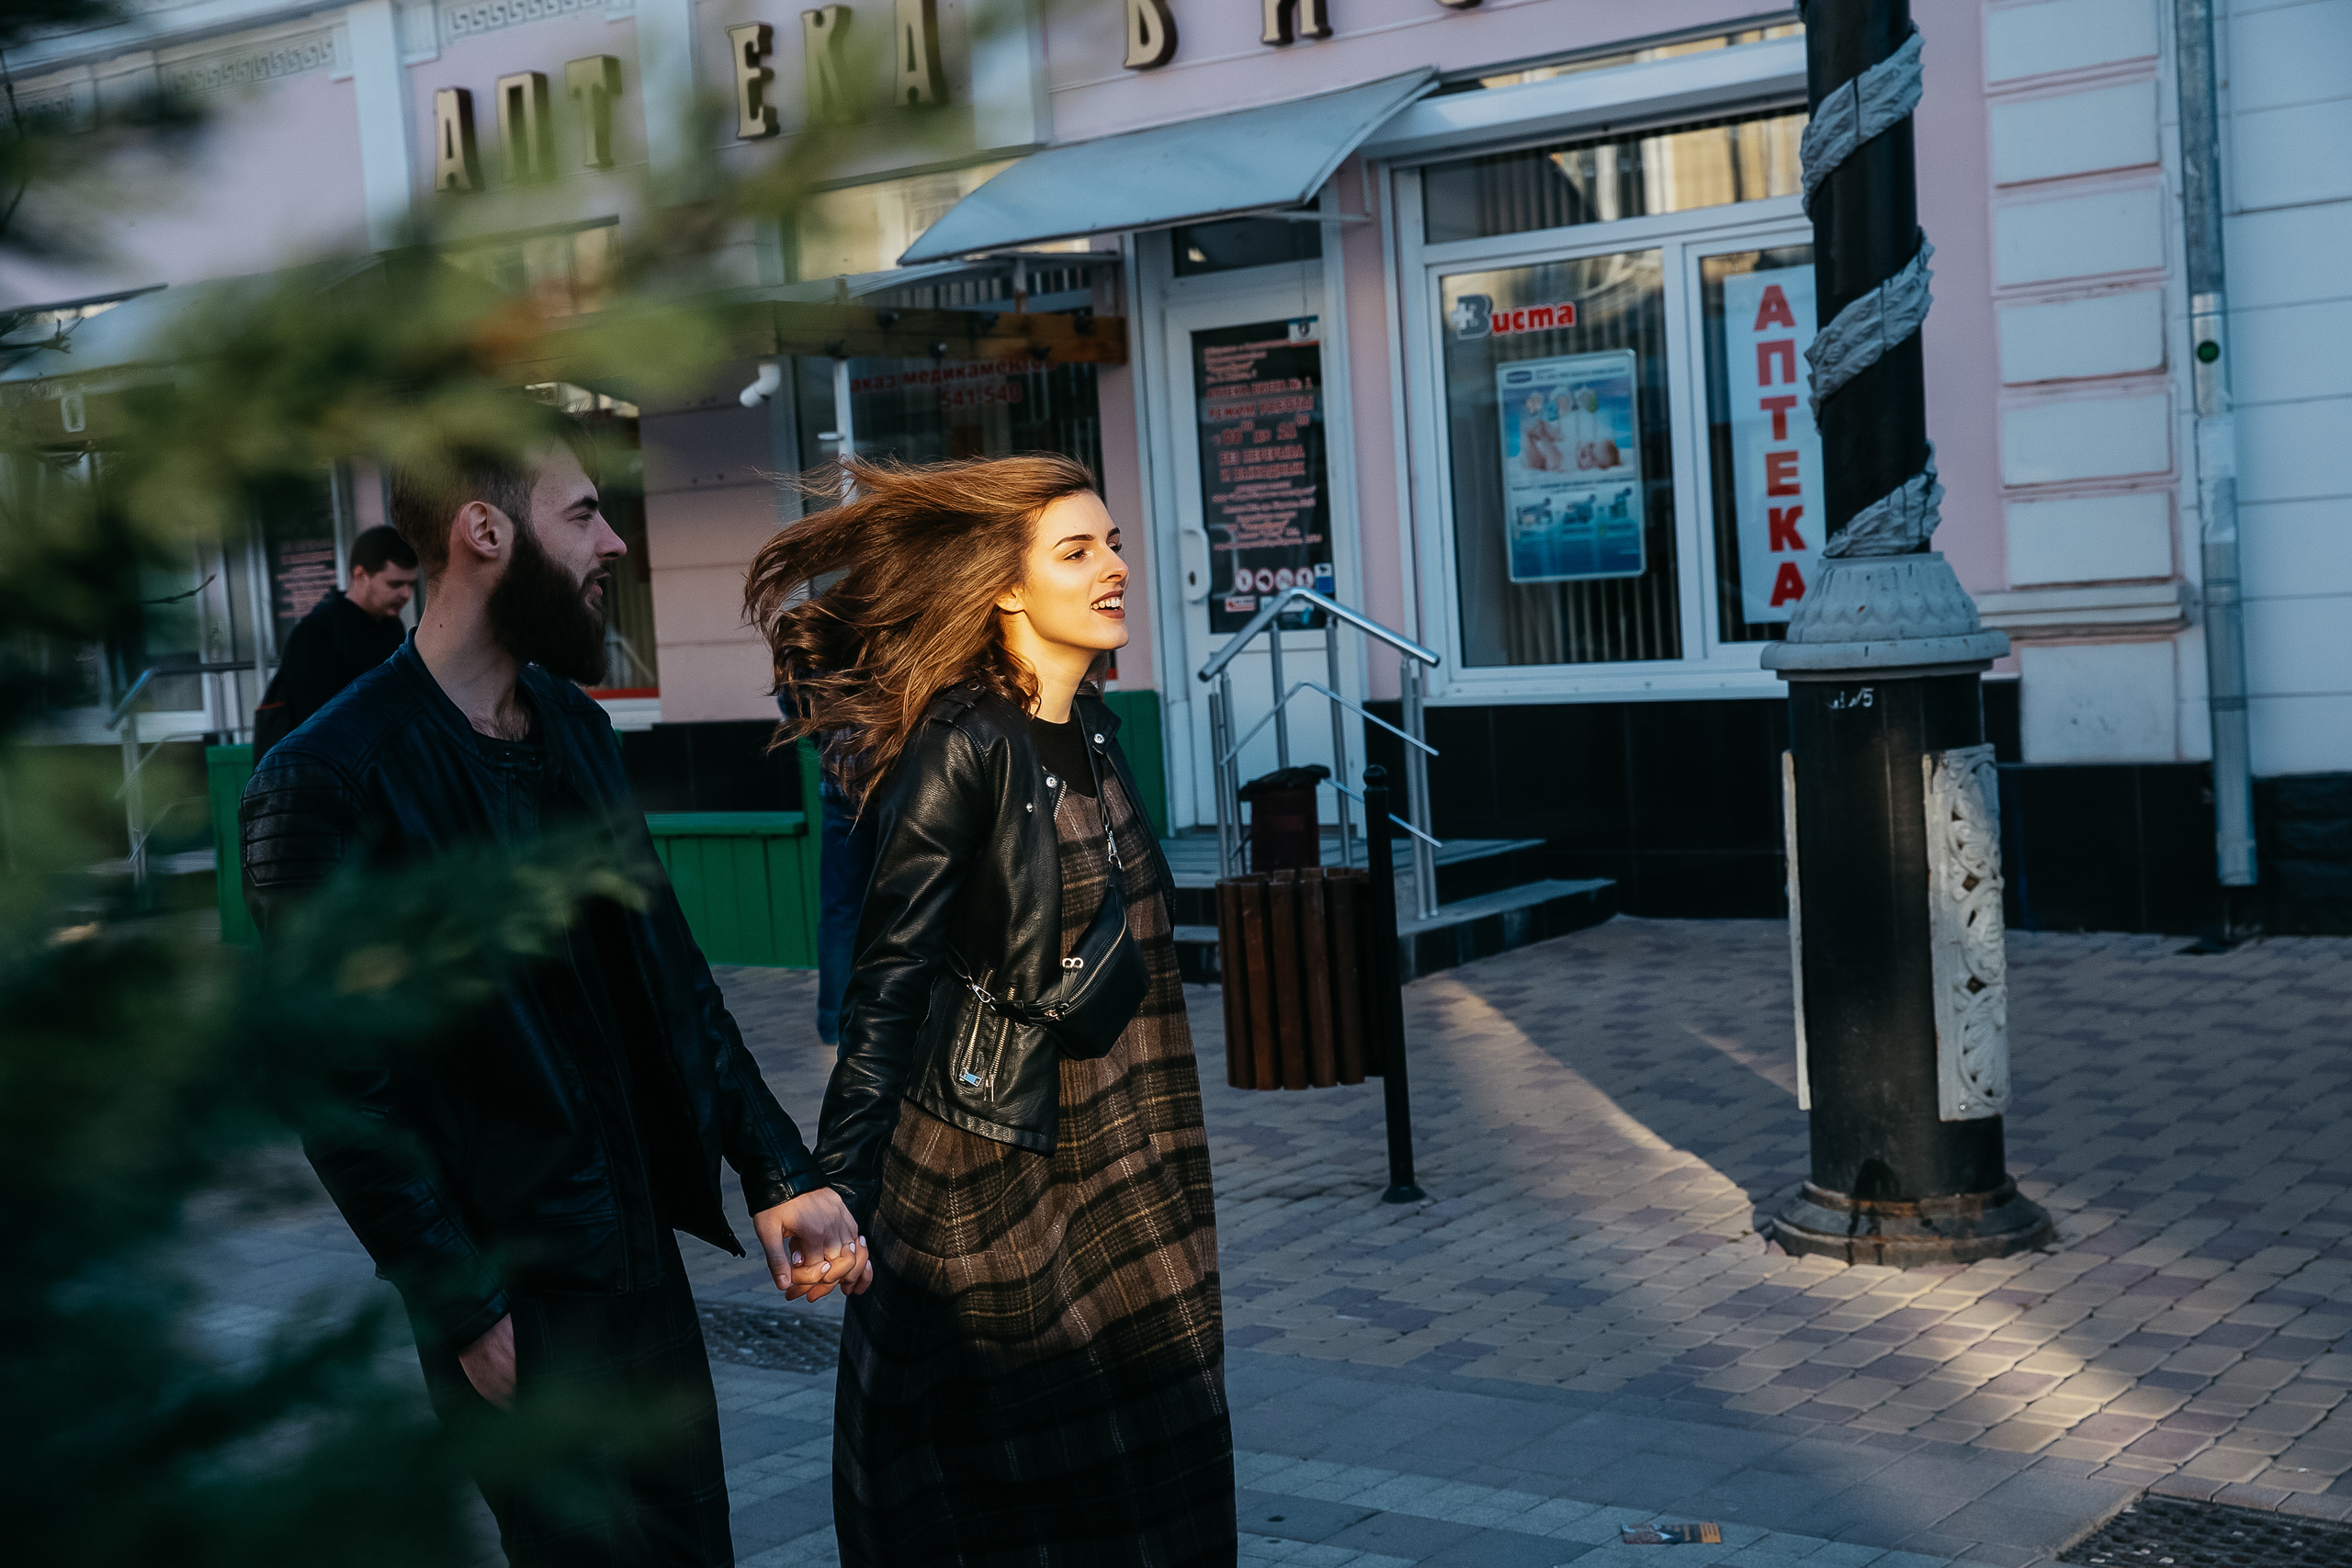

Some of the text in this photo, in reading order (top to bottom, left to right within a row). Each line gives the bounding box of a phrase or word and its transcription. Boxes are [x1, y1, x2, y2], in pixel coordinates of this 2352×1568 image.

[435, 0, 950, 191] АПТЕКА
[1453, 294, 1577, 339] Виста
[850, 375, 898, 393] аказ
[1754, 284, 1807, 607] АПТЕКА
